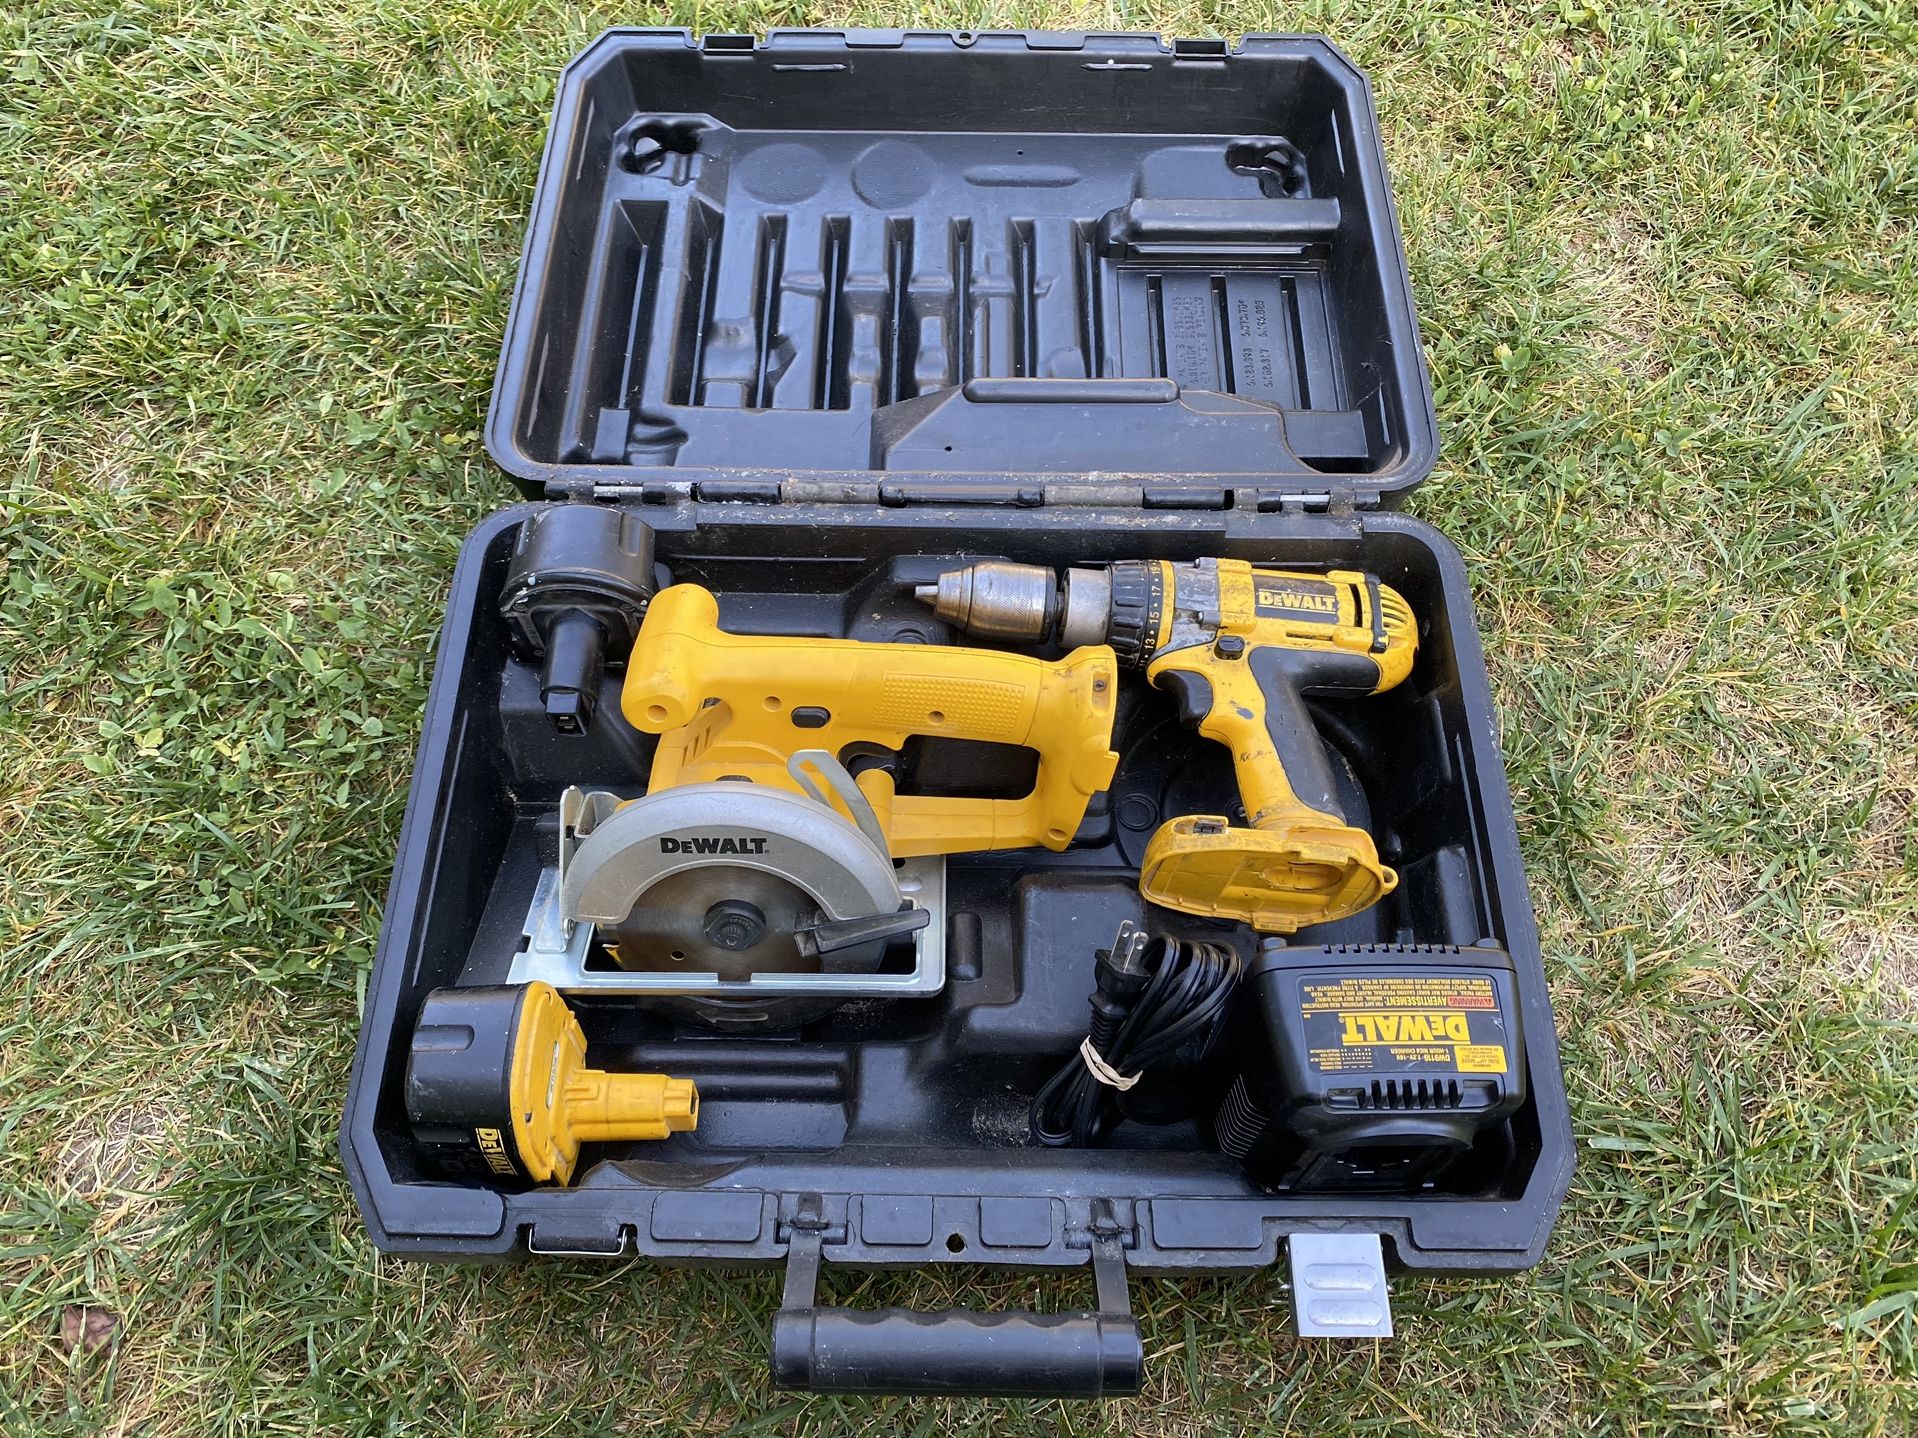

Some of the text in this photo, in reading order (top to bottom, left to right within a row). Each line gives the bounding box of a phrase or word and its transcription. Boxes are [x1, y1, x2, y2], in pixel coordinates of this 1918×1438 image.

[1152, 585, 1161, 597] 17
[1257, 590, 1336, 611] DEWALT
[1150, 611, 1160, 624] 15
[1145, 638, 1156, 650] 13
[660, 838, 767, 854] DEWALT
[1383, 996, 1447, 1006] AVERTISSEMENT:
[1342, 1015, 1470, 1041] DEWALT
